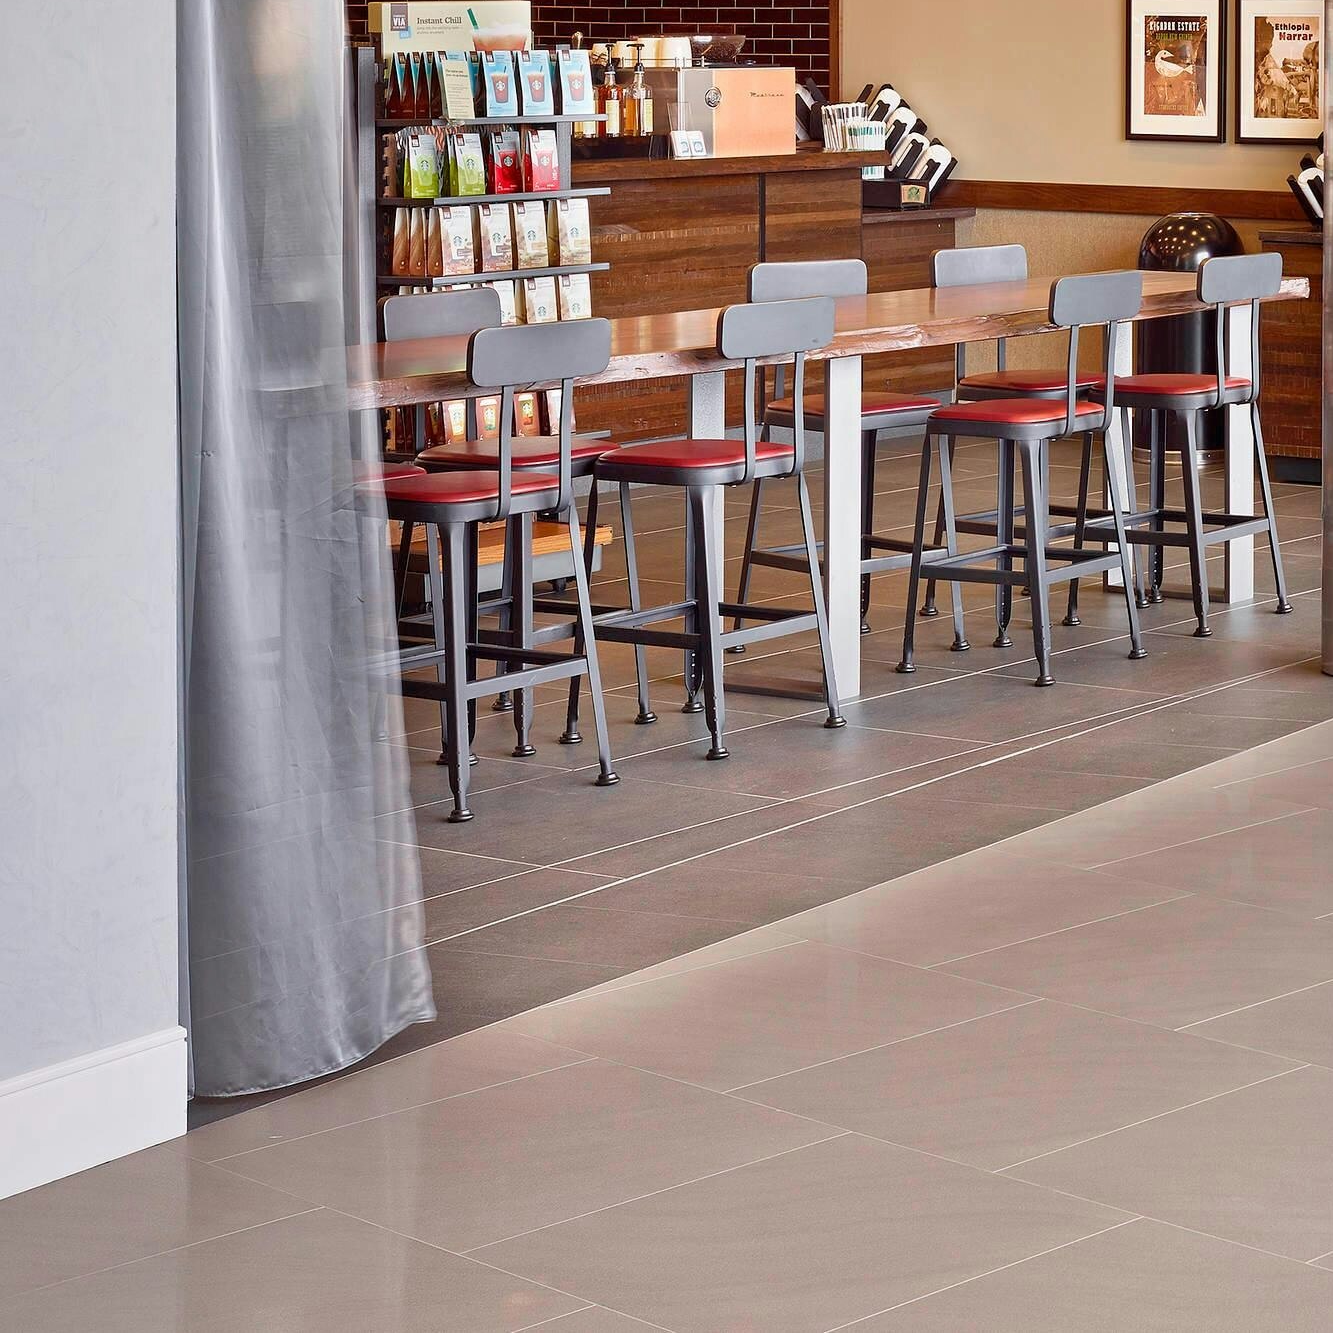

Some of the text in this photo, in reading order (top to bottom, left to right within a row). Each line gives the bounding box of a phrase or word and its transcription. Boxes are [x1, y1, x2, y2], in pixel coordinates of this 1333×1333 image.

[392, 17, 406, 27] VIA
[416, 16, 462, 25] Instant Chill
[1177, 21, 1200, 32] ESTATE
[1274, 23, 1310, 32] Ethiopia
[1278, 32, 1314, 41] Harrar
